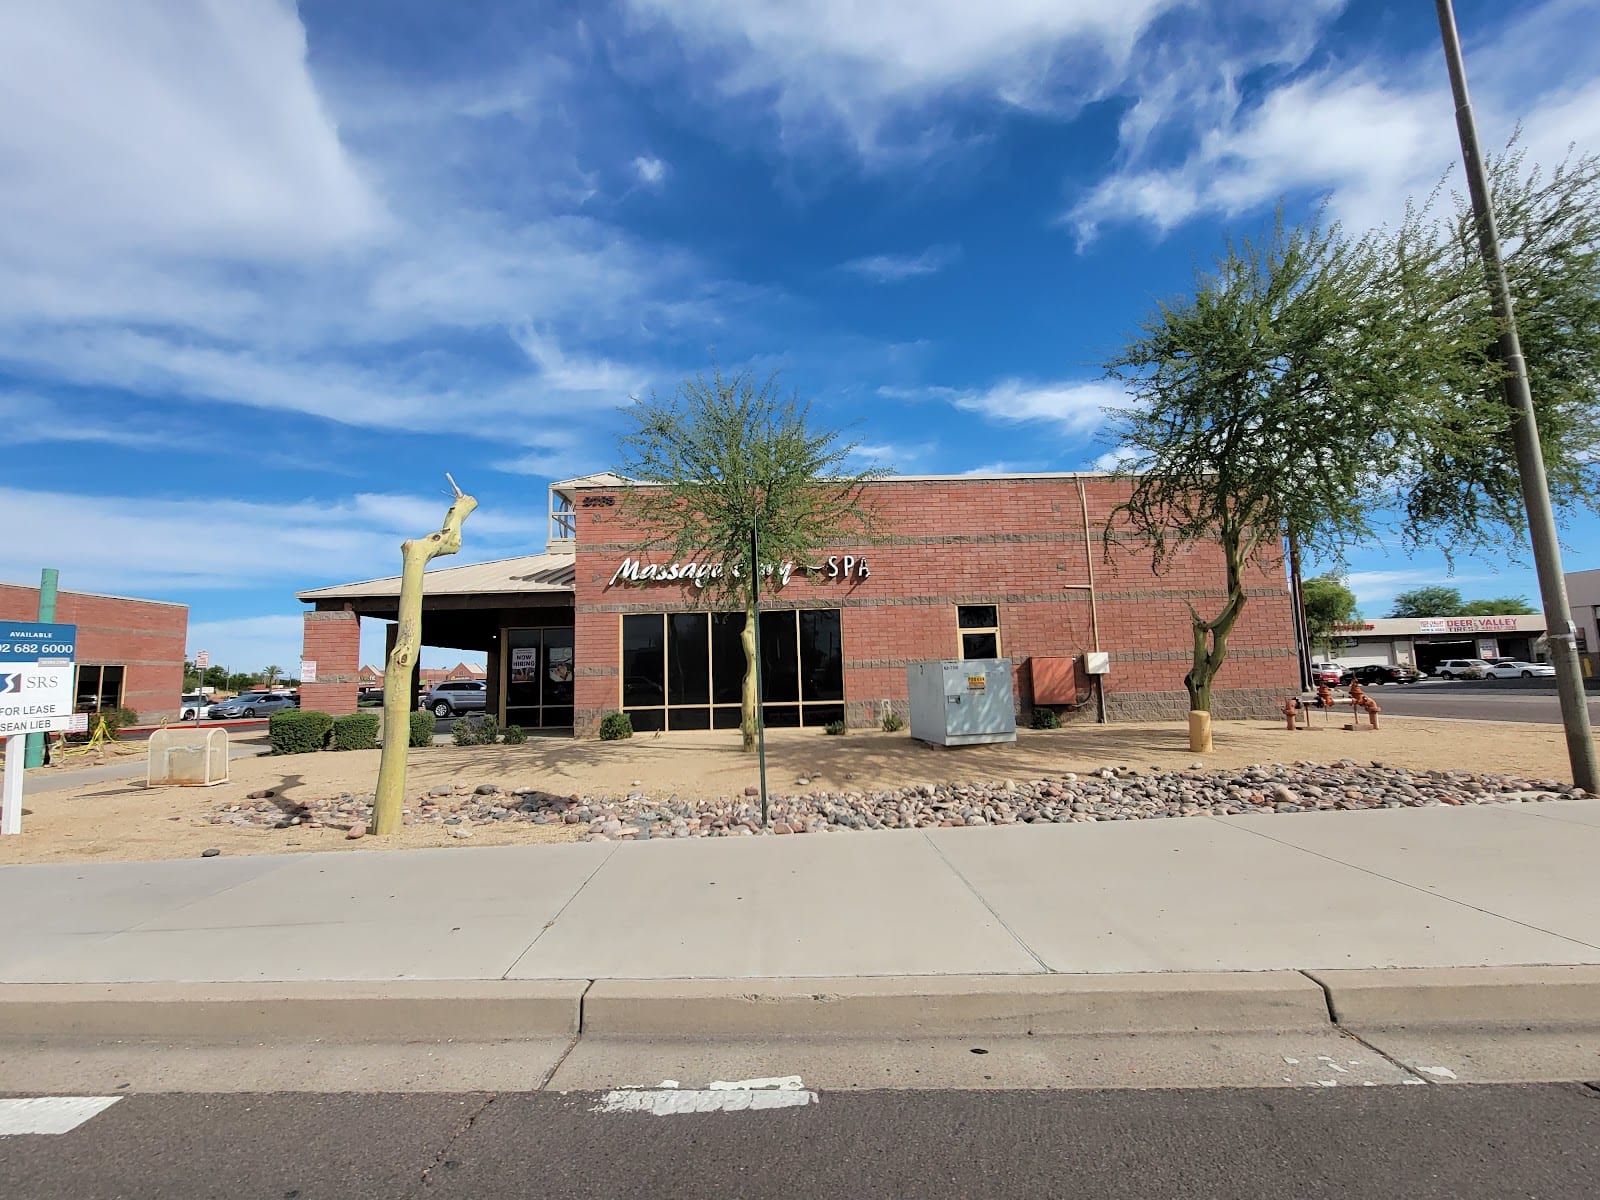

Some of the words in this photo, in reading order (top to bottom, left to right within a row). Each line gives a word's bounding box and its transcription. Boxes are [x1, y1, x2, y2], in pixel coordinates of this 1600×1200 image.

[608, 557, 724, 588] Massage
[828, 555, 871, 578] SPA
[1446, 619, 1473, 627] DEER
[1478, 618, 1518, 626] VALLEY
[0, 643, 11, 653] 2
[14, 643, 38, 653] 682
[41, 644, 73, 654] 6000
[26, 675, 58, 689] SRS
[23, 704, 56, 715] LEASE
[0, 721, 27, 732] SEAN
[30, 719, 51, 729] LIEB
